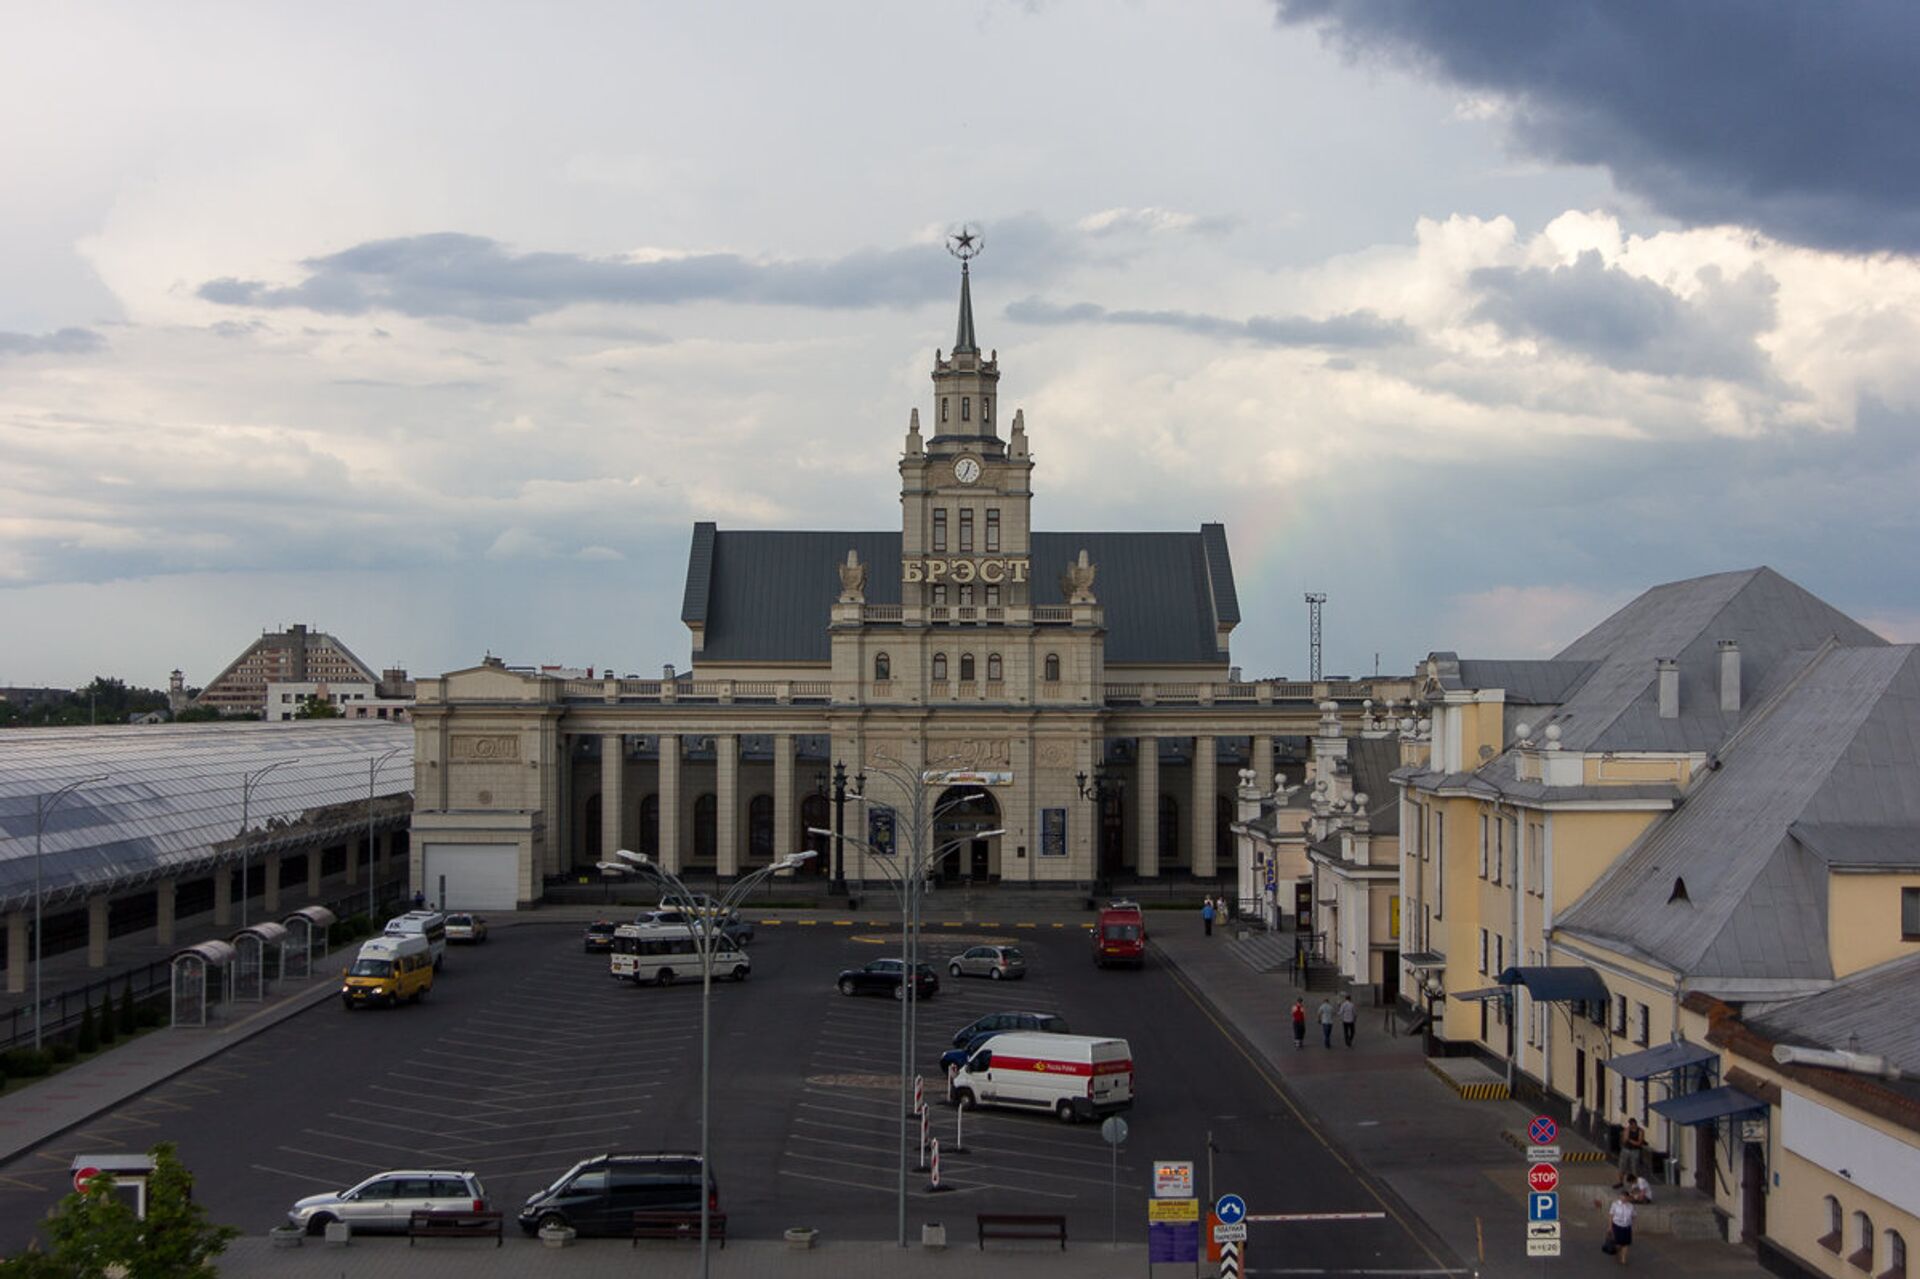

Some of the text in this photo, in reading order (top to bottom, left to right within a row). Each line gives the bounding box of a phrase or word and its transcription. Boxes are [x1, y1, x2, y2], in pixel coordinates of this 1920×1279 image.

[901, 559, 1029, 583] БРЭСТ
[1531, 1173, 1556, 1182] STOP
[1537, 1195, 1553, 1218] P
